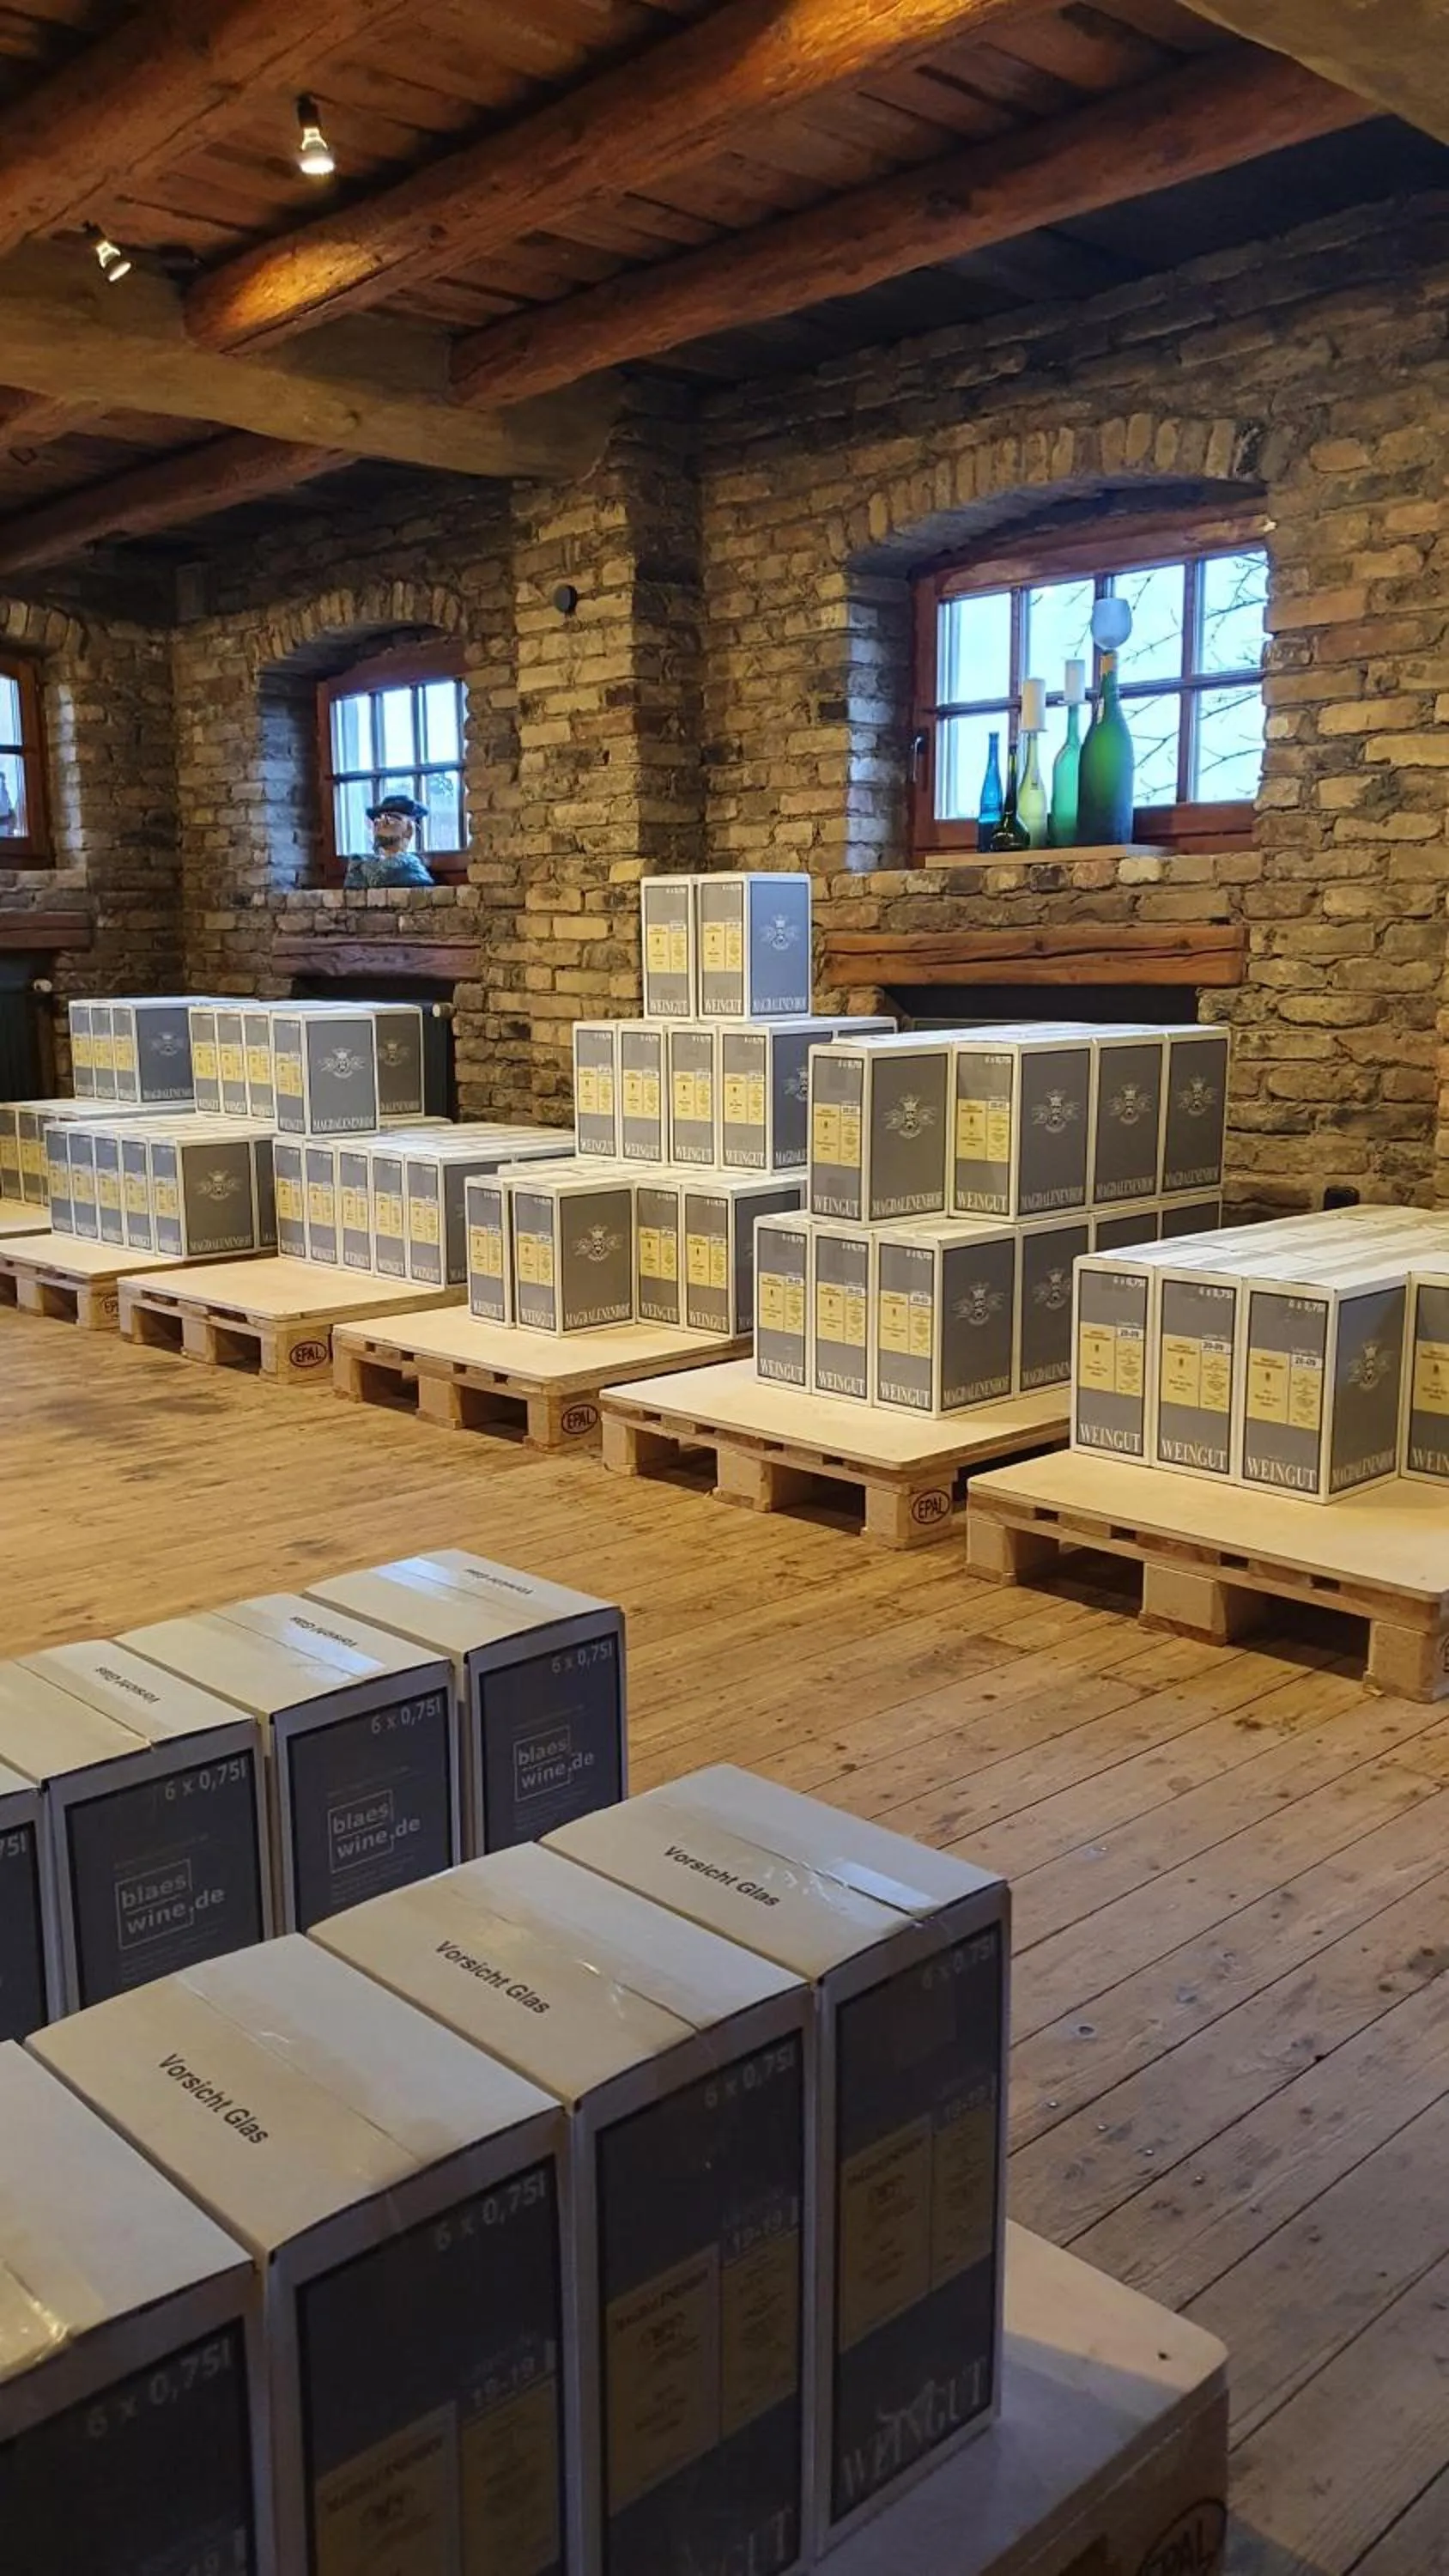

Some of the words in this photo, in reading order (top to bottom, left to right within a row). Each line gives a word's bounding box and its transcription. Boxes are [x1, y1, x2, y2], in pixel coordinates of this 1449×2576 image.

[814, 1195, 859, 1217] WEINGUT
[957, 1191, 1008, 1212] WEINGUT
[295, 1345, 323, 1364] EPAL
[760, 1358, 804, 1382] WEINGUT
[818, 1370, 865, 1393] WEINGUT
[880, 1381, 931, 1406] WEINGUT
[567, 1410, 592, 1428] EPAL
[1079, 1423, 1141, 1453] WEINGUT
[1161, 1438, 1228, 1470] WEINGUT
[1246, 1455, 1318, 1490] WEINGUT
[917, 1495, 945, 1518] EPAL
[551, 1656, 560, 1674] 6
[577, 1640, 613, 1668] 0,75l
[371, 1713, 381, 1735] 6
[400, 1696, 441, 1727] 0,75l
[518, 1737, 567, 1766] blaes
[165, 1784, 176, 1801] 6
[199, 1757, 247, 1792] 0,75l
[332, 1801, 390, 1835] blaes
[336, 1817, 421, 1859] wine.de
[121, 1874, 188, 1911] blaes
[664, 1845, 739, 1886] Vorsicht
[736, 1881, 780, 1906] Glas
[125, 1888, 227, 1934] wine.de
[435, 1940, 512, 1989] Vorsicht
[506, 1984, 550, 2014] Glas
[159, 2052, 233, 2114] Vorsicht
[223, 2108, 270, 2144] Glas
[703, 2085, 718, 2110] 6
[434, 2222, 453, 2252] 6
[481, 2170, 547, 2227] 0,75l
[86, 2404, 109, 2440] 6
[148, 2337, 234, 2405] 0,75l
